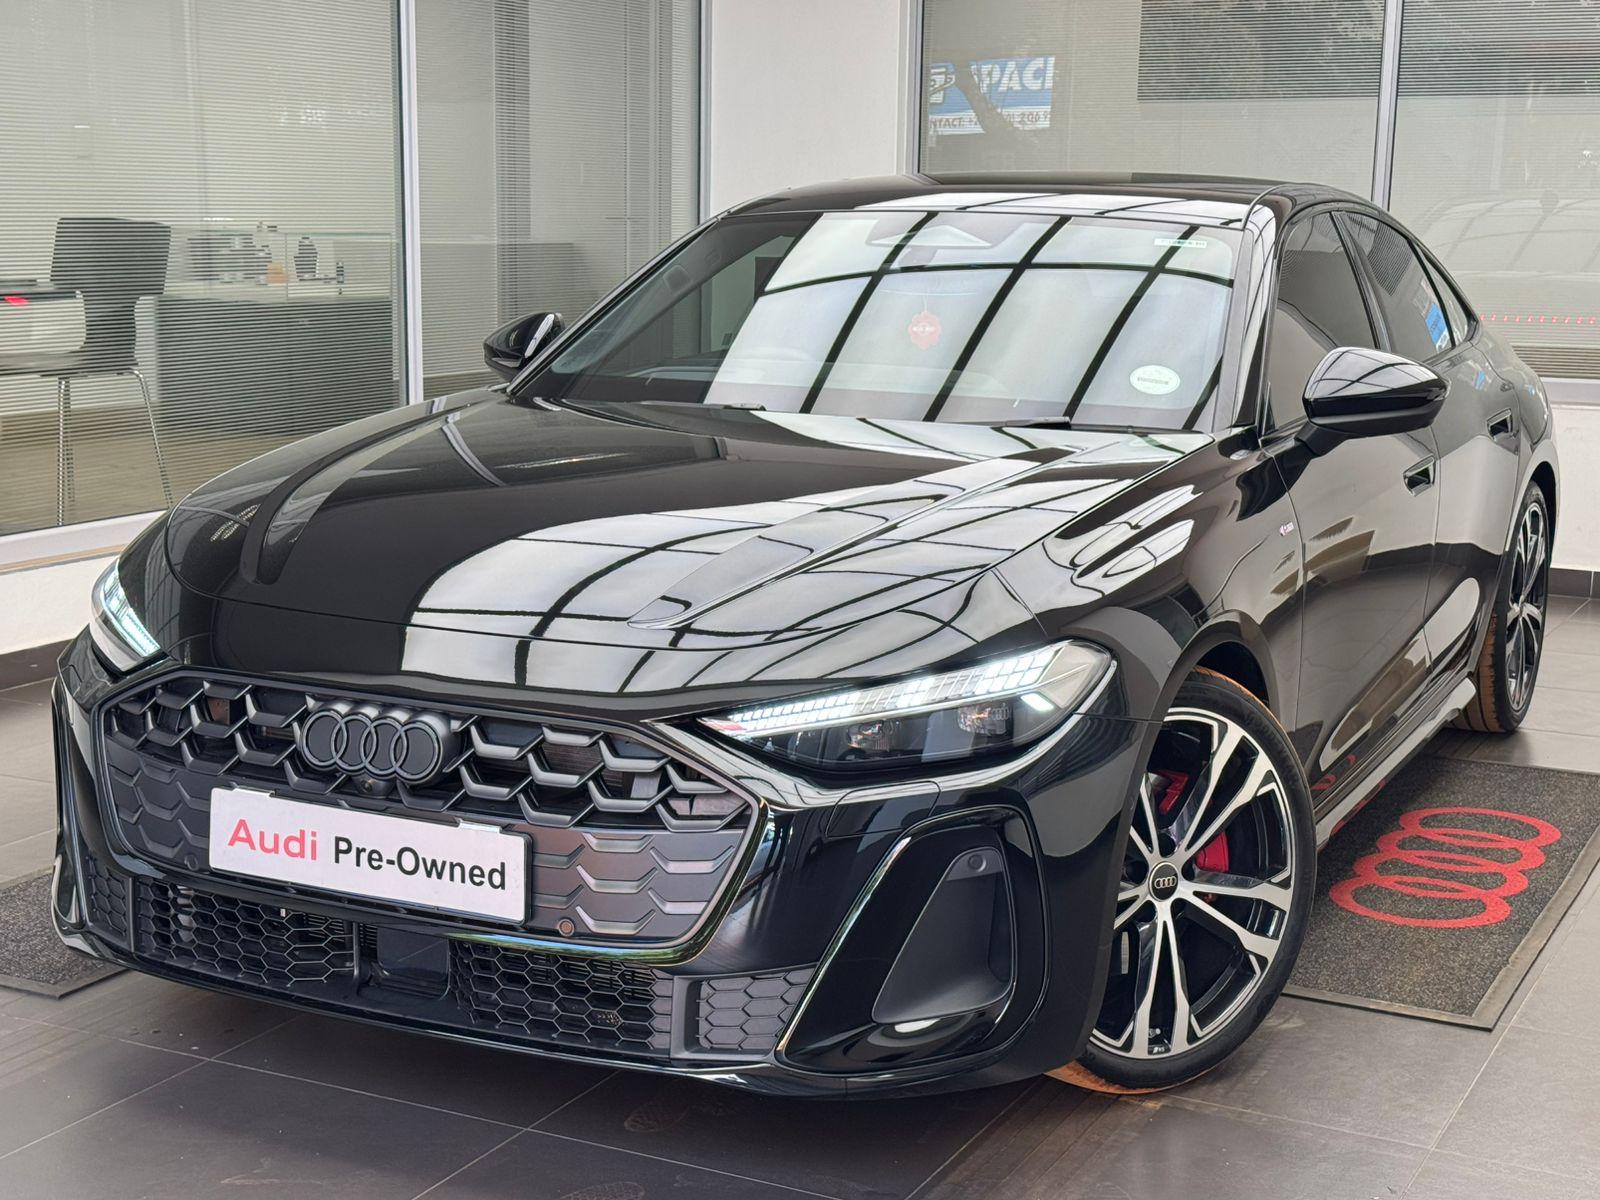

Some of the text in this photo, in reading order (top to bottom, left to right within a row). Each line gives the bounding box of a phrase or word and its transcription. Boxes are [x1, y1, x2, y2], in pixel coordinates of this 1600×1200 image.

[970, 57, 1055, 92] PAC
[227, 819, 506, 890] Audi Pre-Owned
